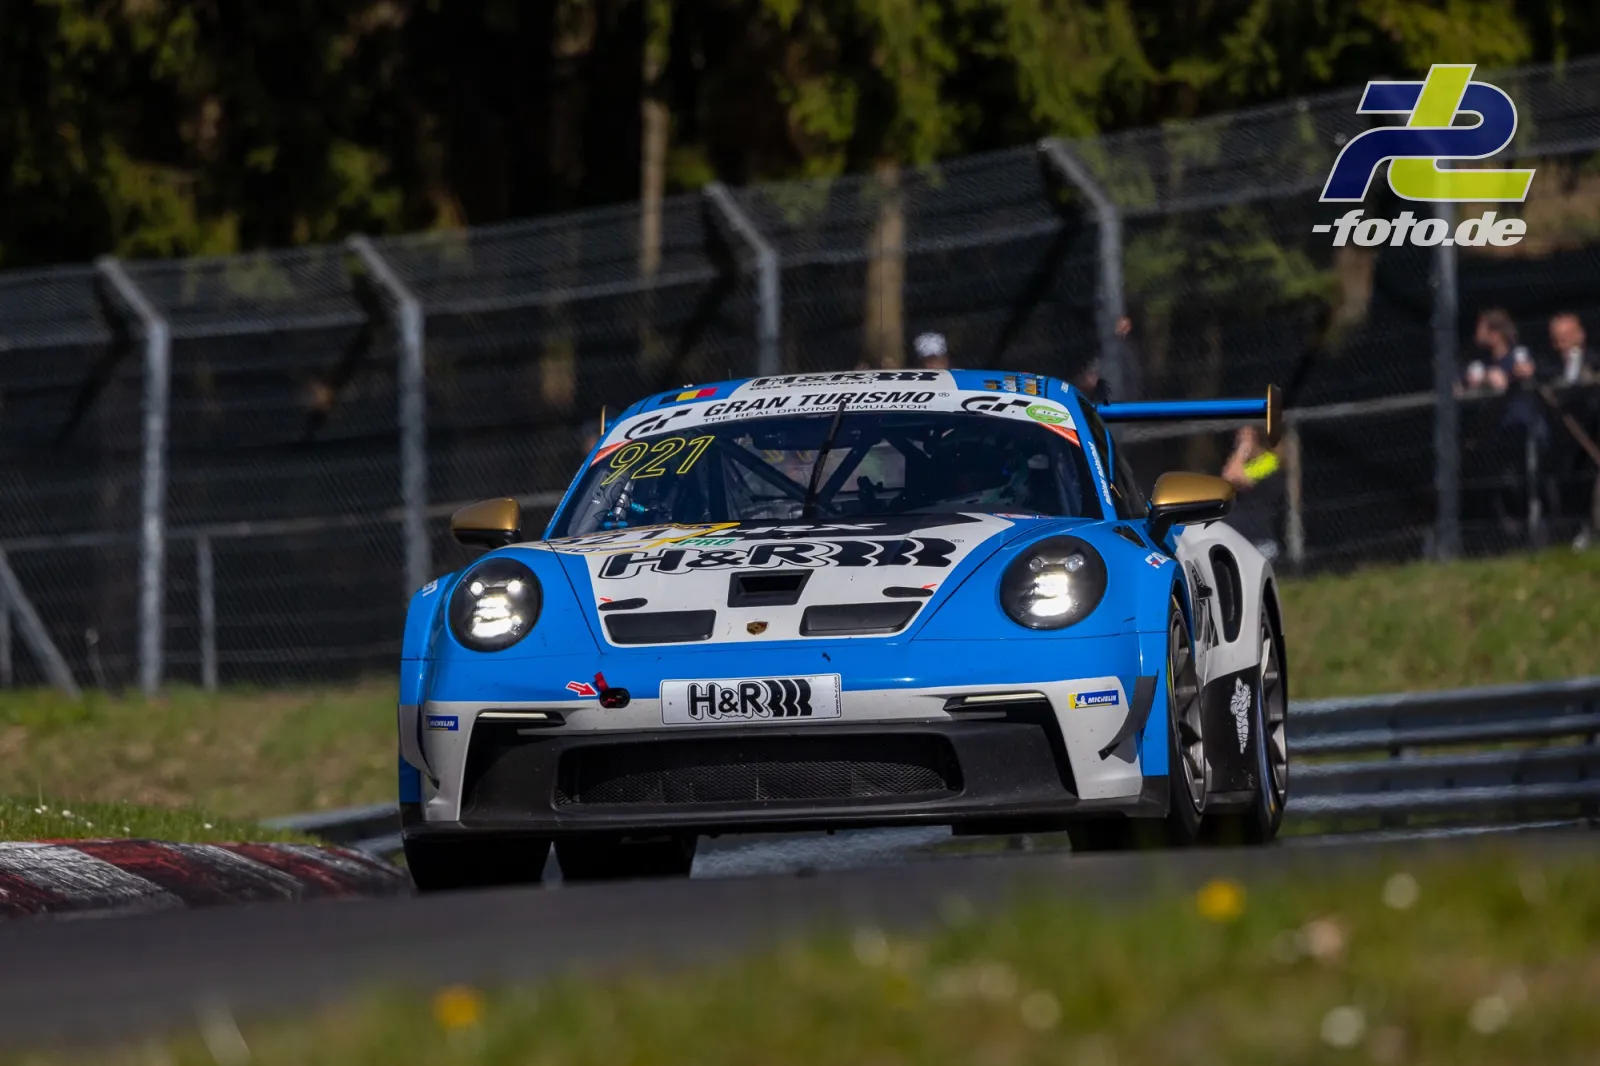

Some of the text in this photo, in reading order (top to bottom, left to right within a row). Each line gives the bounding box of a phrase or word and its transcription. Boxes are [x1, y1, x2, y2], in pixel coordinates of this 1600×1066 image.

[703, 391, 936, 417] GRAN TURISMO
[703, 403, 928, 423] THE REAL DRIVING SIMULATOR
[600, 435, 715, 486] 921
[678, 538, 737, 548] PRO
[598, 541, 834, 580] H&R
[687, 681, 770, 720] H&R
[1087, 695, 1117, 704] MICHELIN
